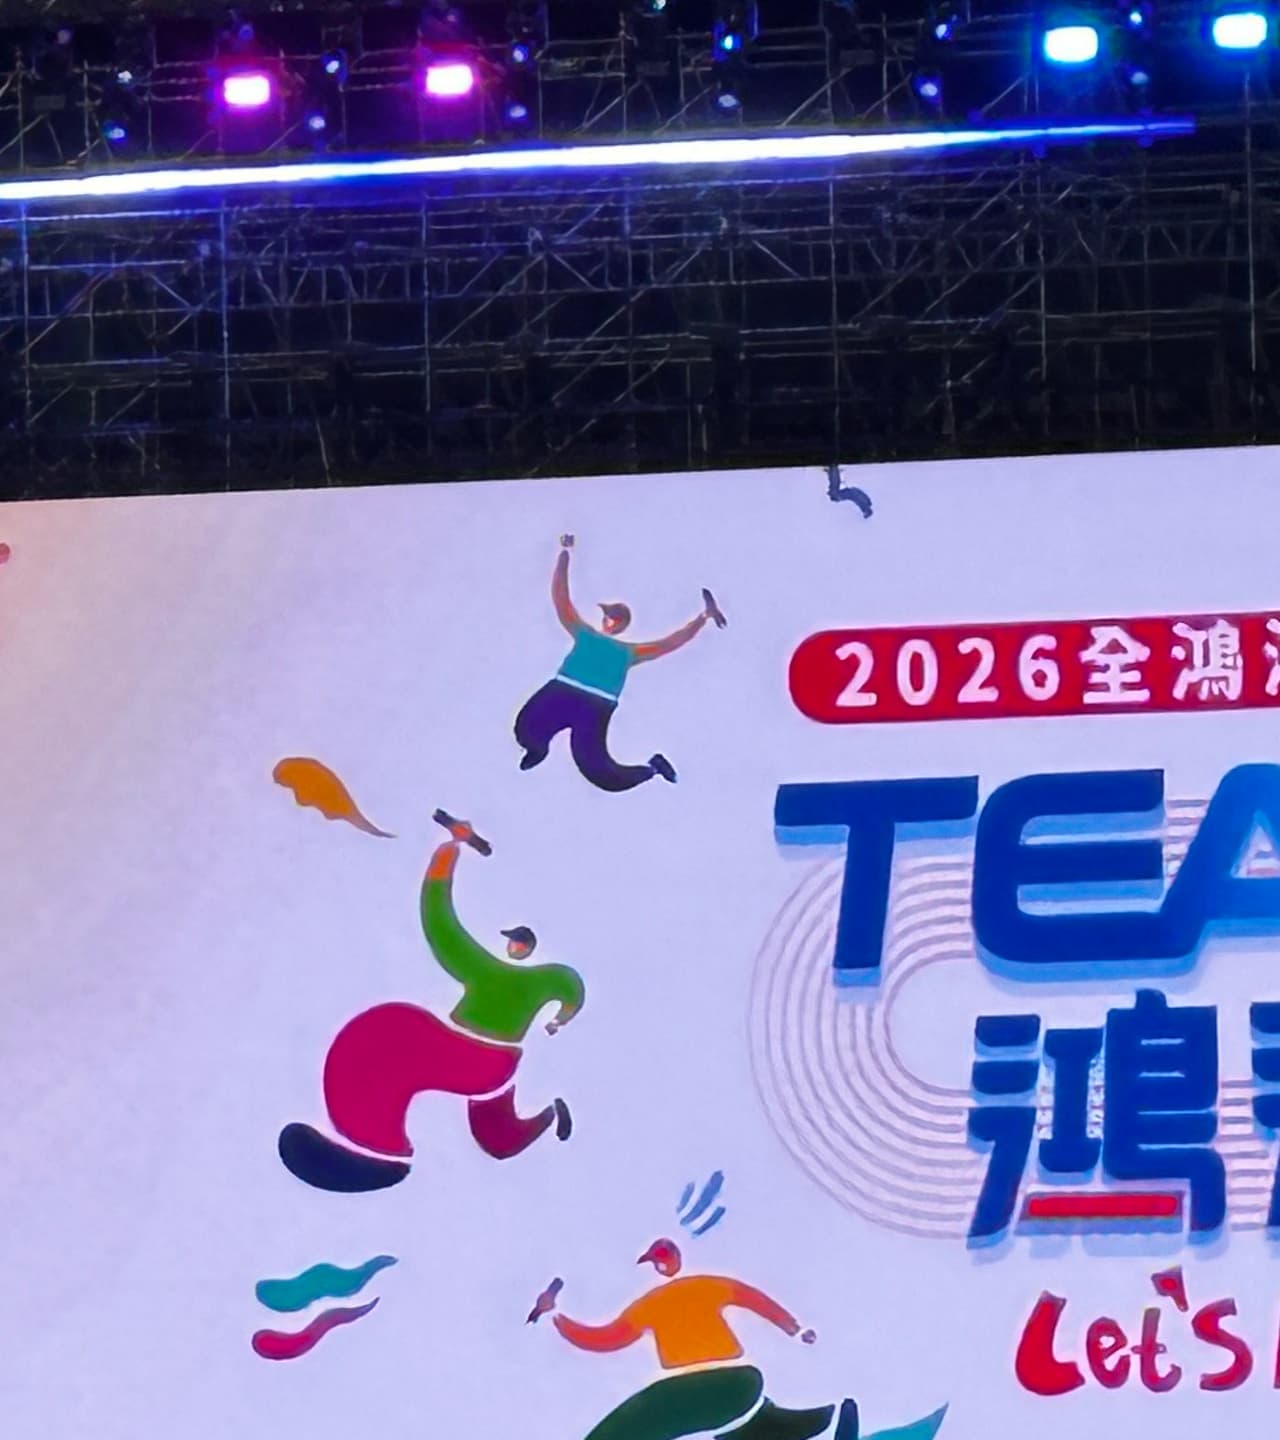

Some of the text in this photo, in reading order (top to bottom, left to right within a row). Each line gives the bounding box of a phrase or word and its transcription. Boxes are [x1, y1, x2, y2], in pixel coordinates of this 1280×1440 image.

[834, 618, 1280, 707] 2026全鴻
[966, 988, 1280, 1240] 鴻
[1015, 1265, 1254, 1397] Let's
